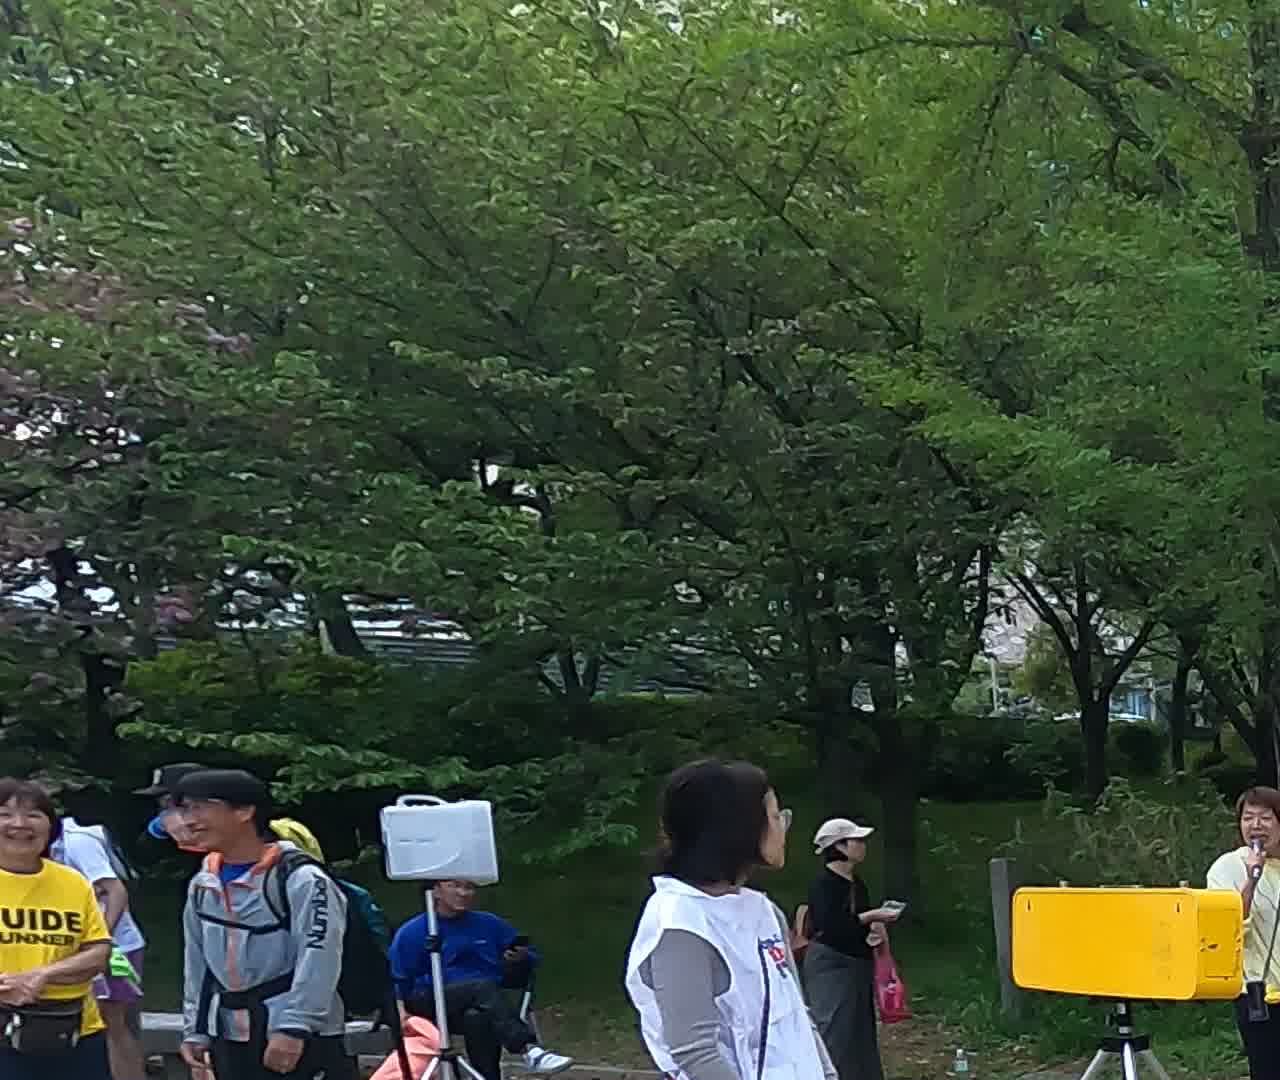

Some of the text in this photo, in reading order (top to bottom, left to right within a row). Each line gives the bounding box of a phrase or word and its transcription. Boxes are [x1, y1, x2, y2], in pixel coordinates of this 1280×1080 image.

[0, 908, 82, 933] UIDE
[304, 872, 330, 951] Number
[0, 931, 75, 946] UNNER
